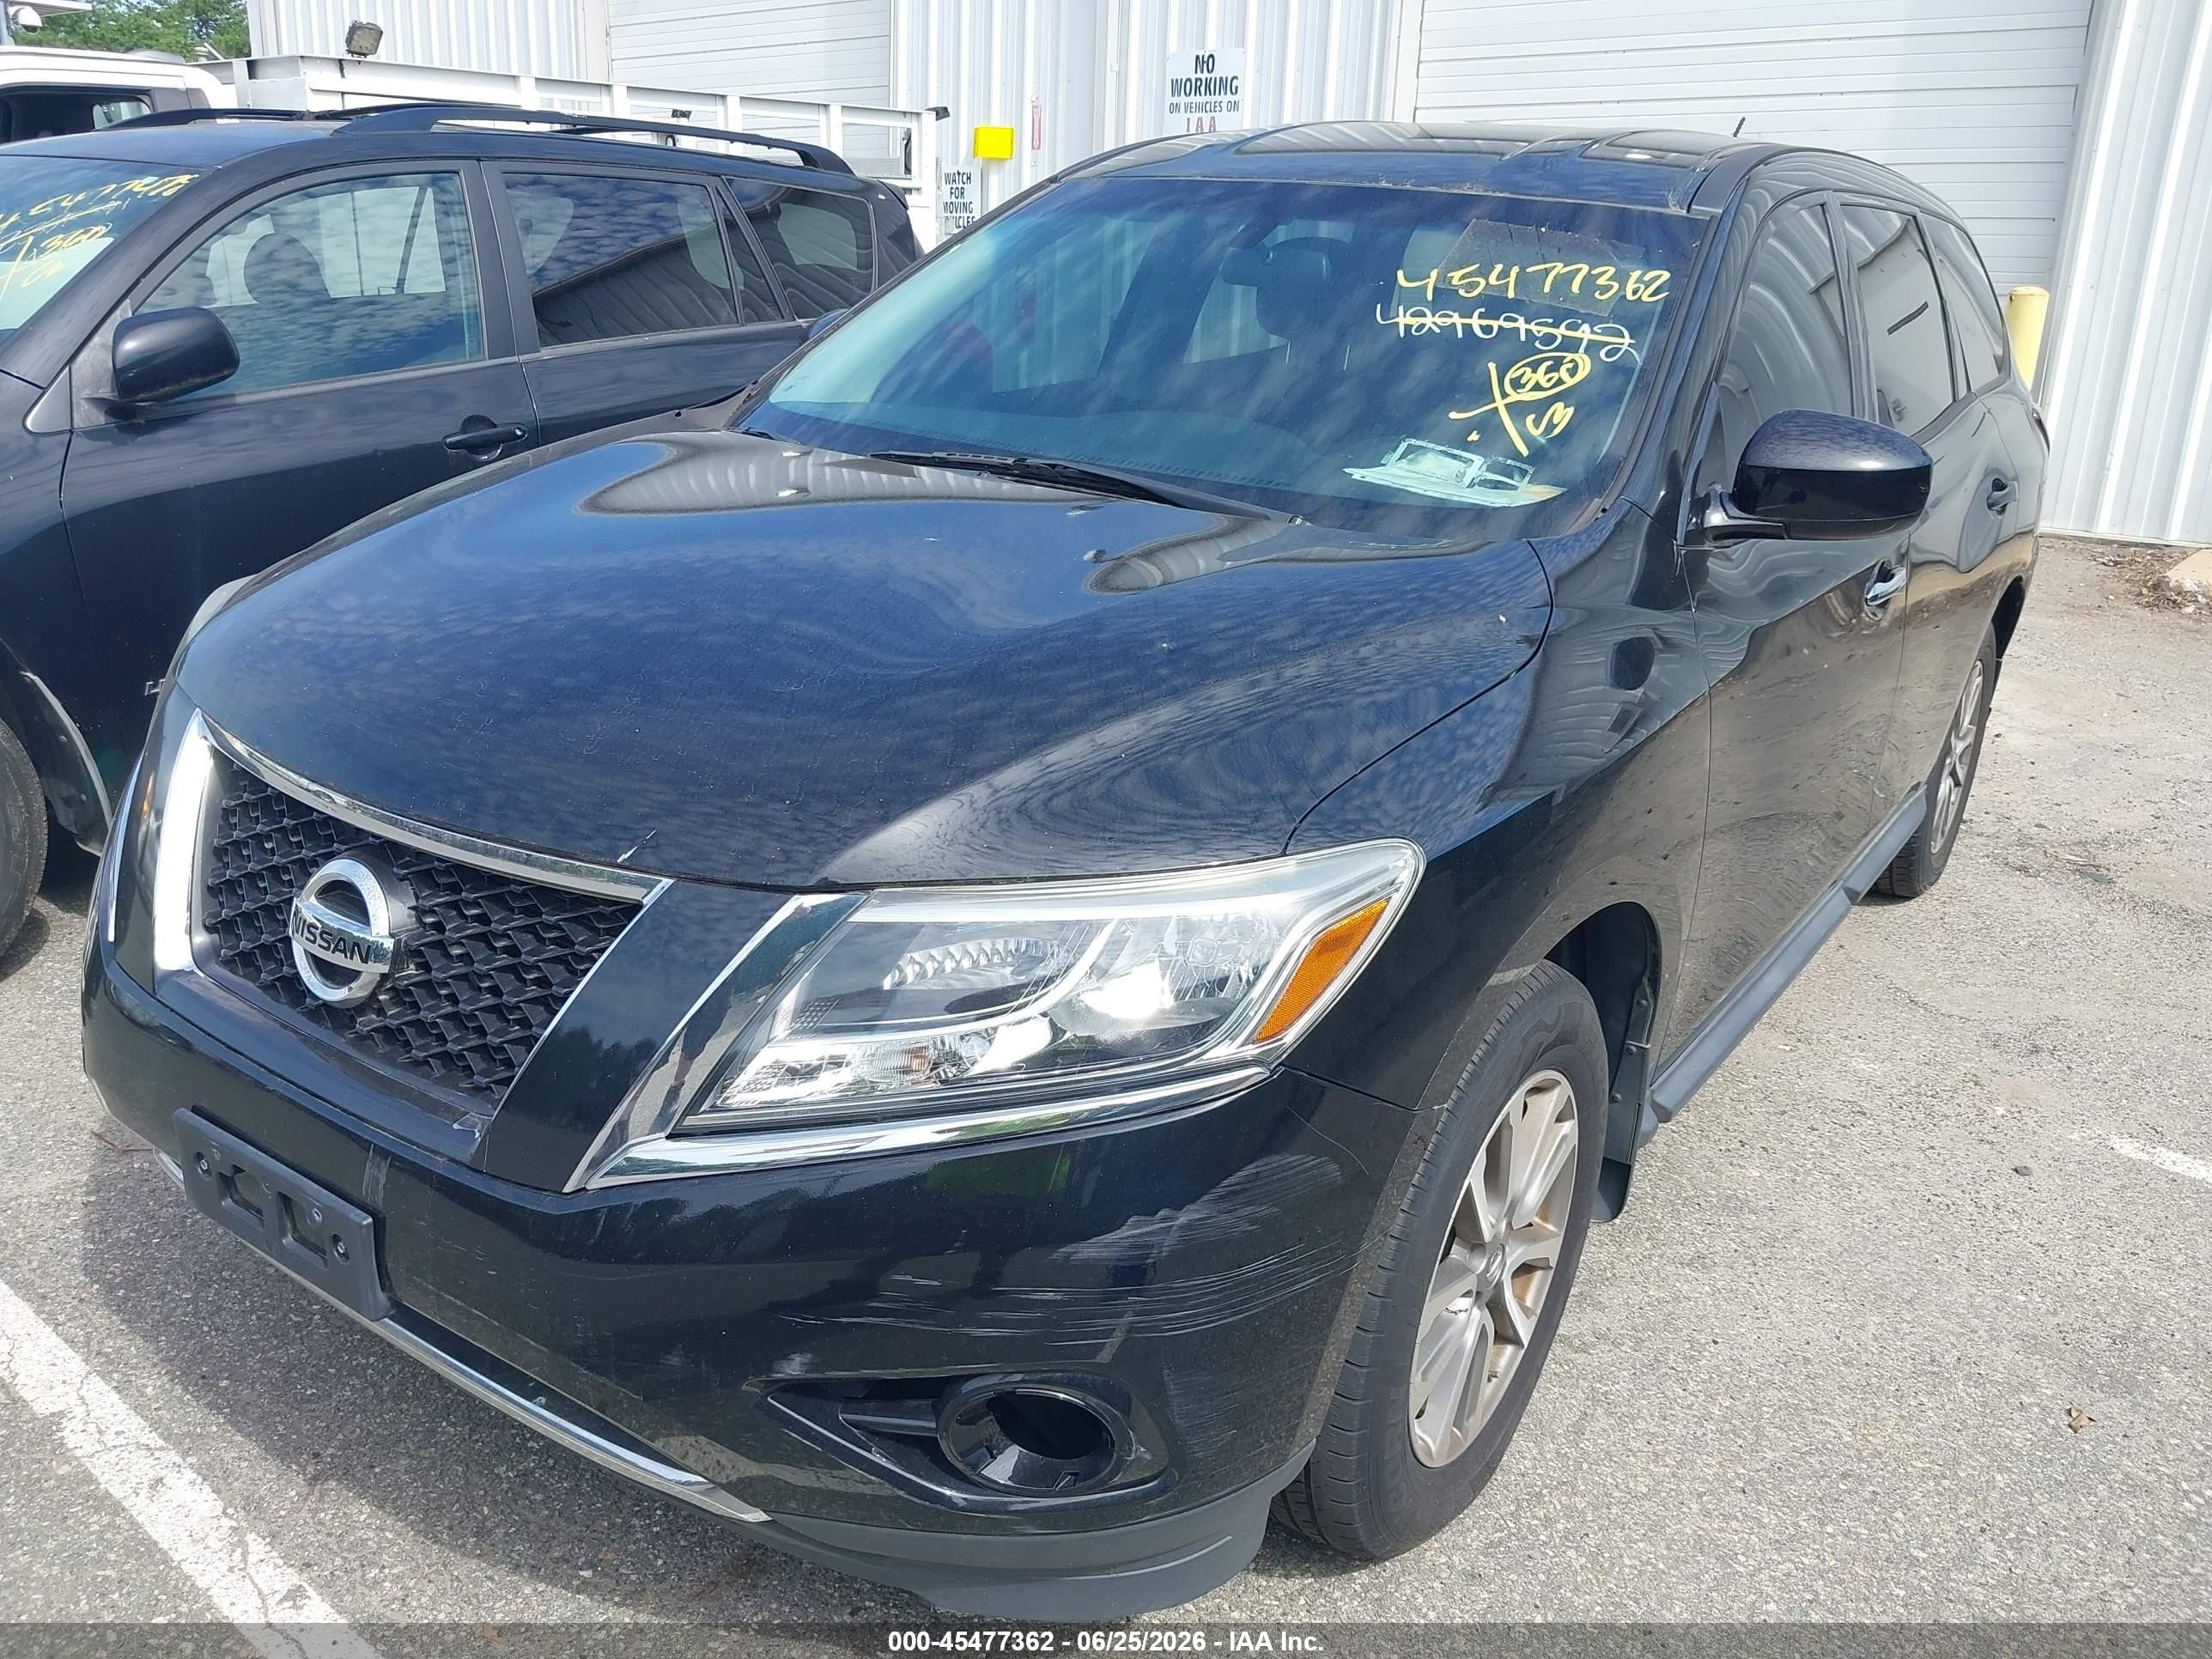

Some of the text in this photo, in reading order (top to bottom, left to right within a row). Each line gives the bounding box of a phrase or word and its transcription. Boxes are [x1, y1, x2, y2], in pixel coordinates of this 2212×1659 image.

[1194, 53, 1216, 75] NO
[1170, 76, 1239, 98] WORKING
[1169, 100, 1240, 114] ON VEHICLES ON
[944, 171, 972, 185] WATCH
[950, 186, 965, 199] FOR
[943, 201, 974, 214] MOVING
[1395, 262, 1671, 302] 45477362
[291, 908, 373, 964] NISSAN
